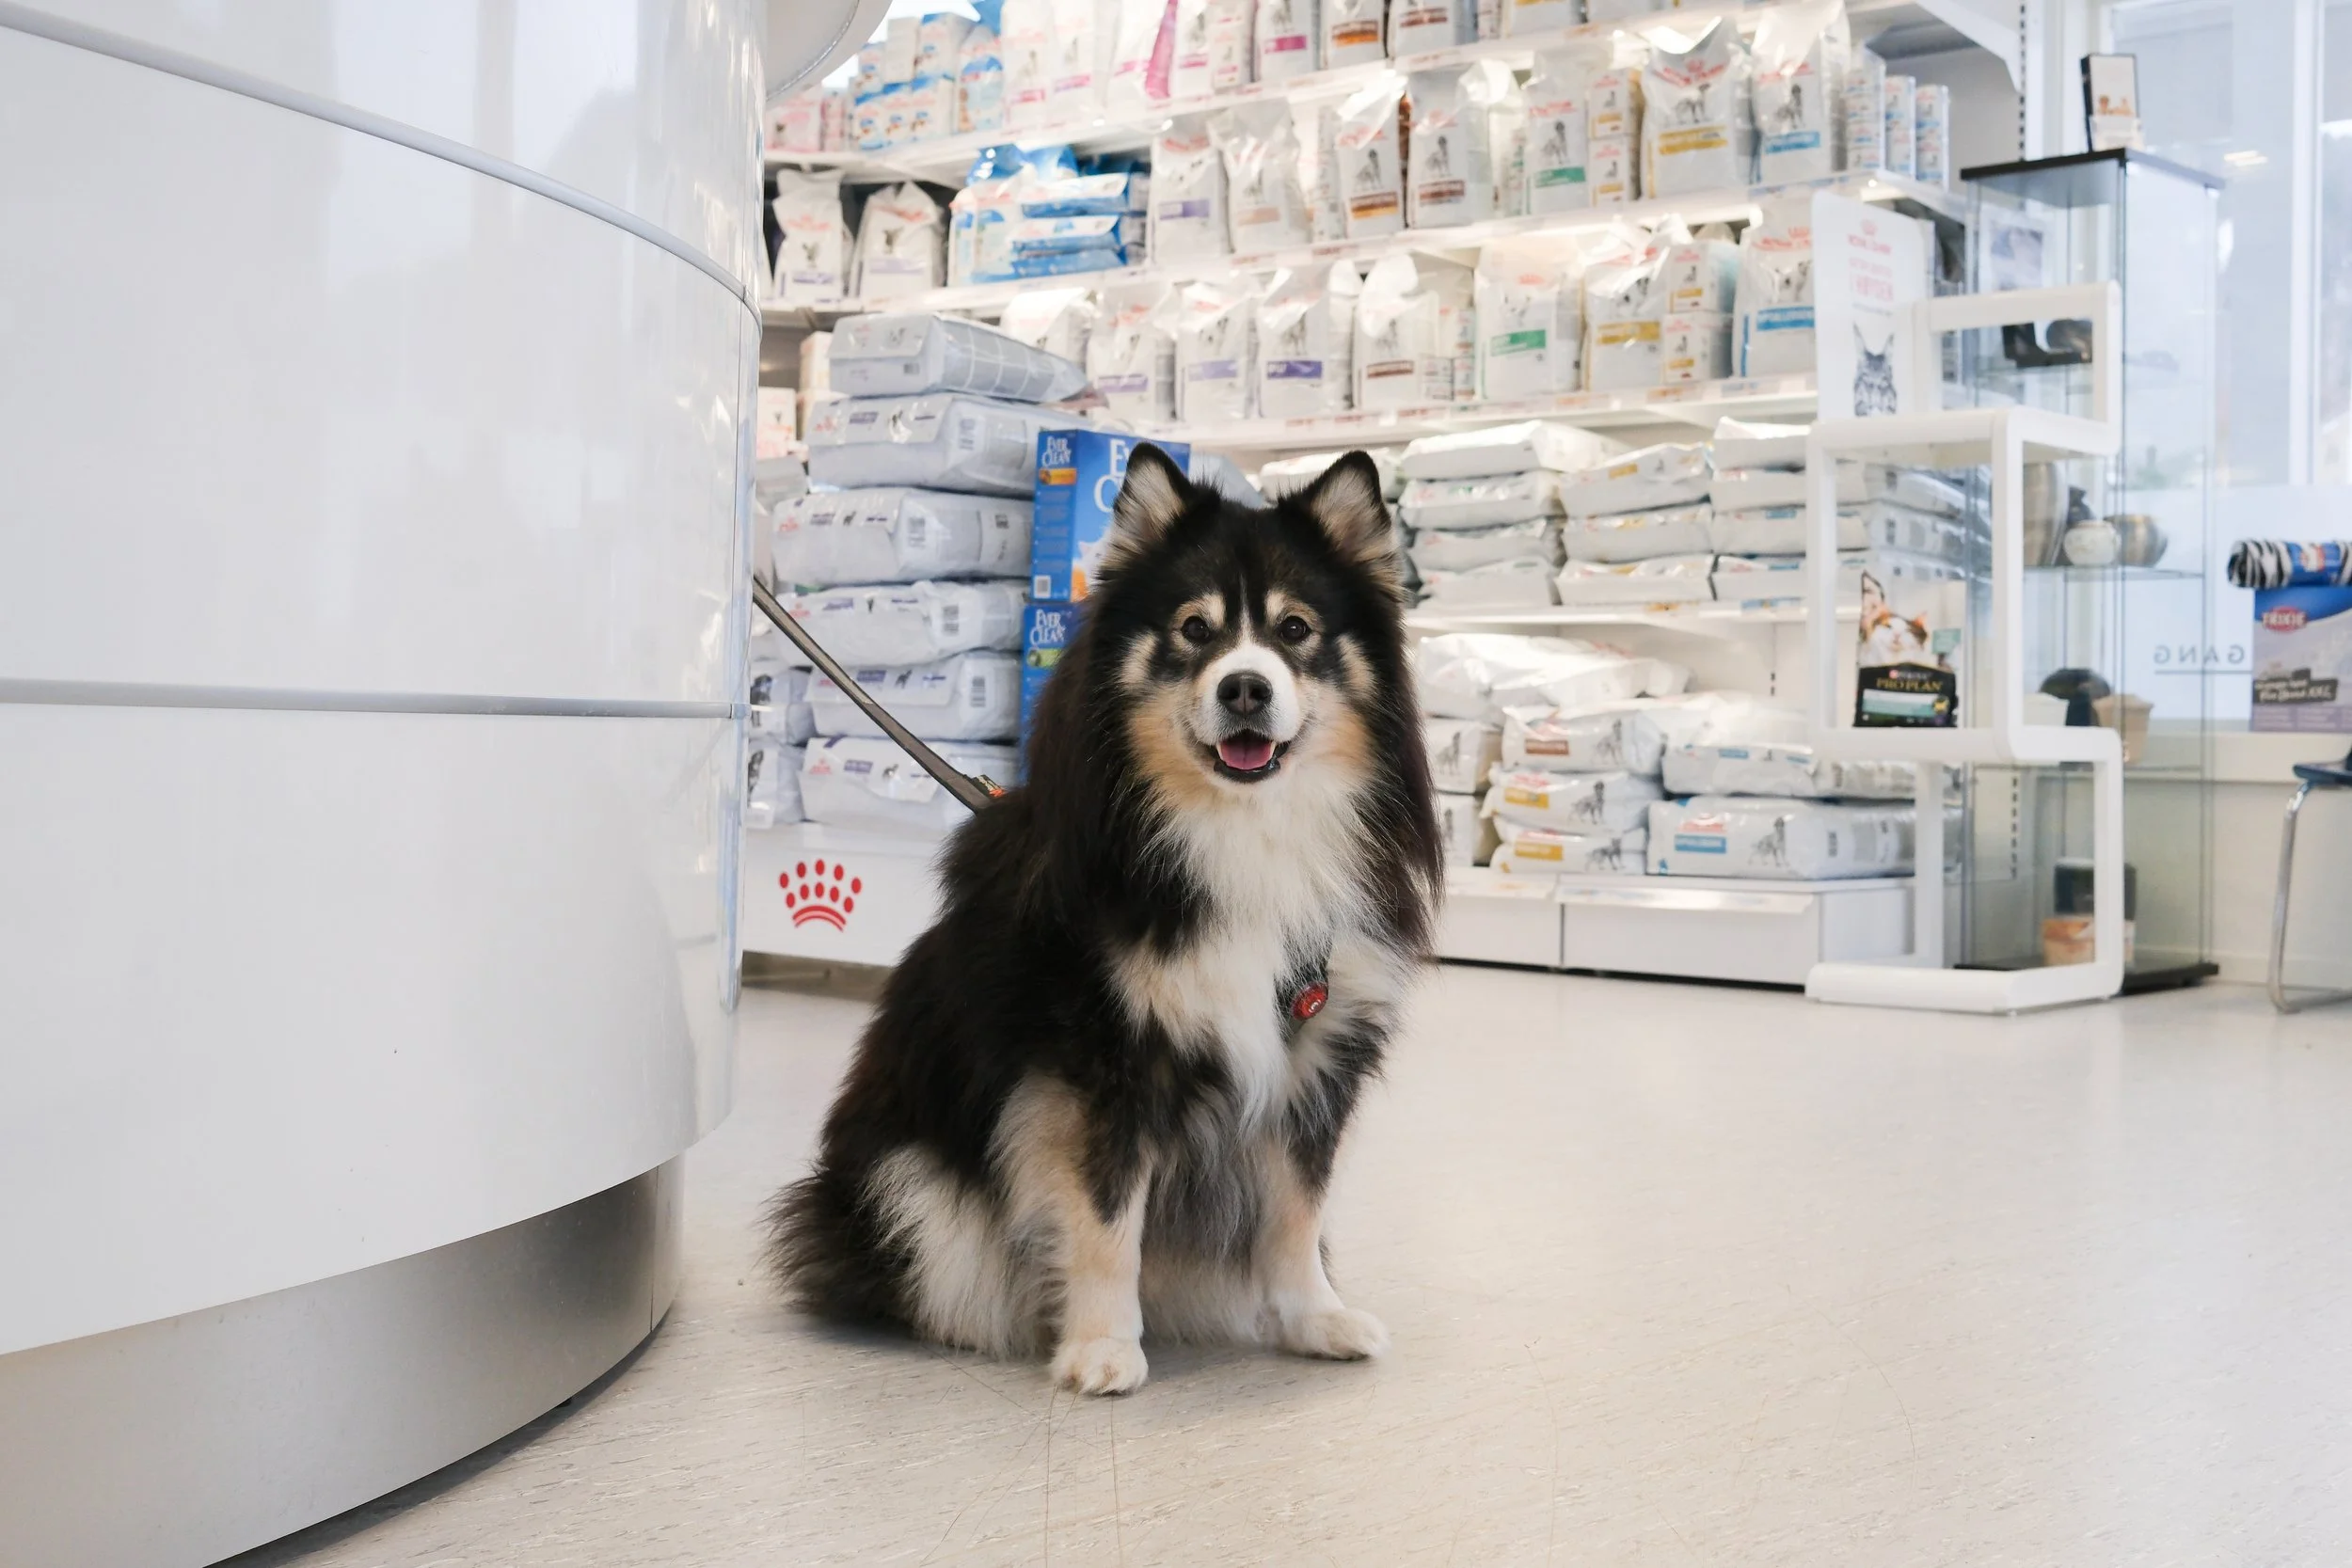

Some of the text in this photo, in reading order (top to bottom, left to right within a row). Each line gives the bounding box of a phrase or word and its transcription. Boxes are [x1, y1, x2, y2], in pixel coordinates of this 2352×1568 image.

[1046, 436, 1069, 453] EVER
[1041, 449, 1073, 467] CLEAN
[1036, 610, 1061, 628] EVER
[1030, 625, 1066, 646] CLEAN
